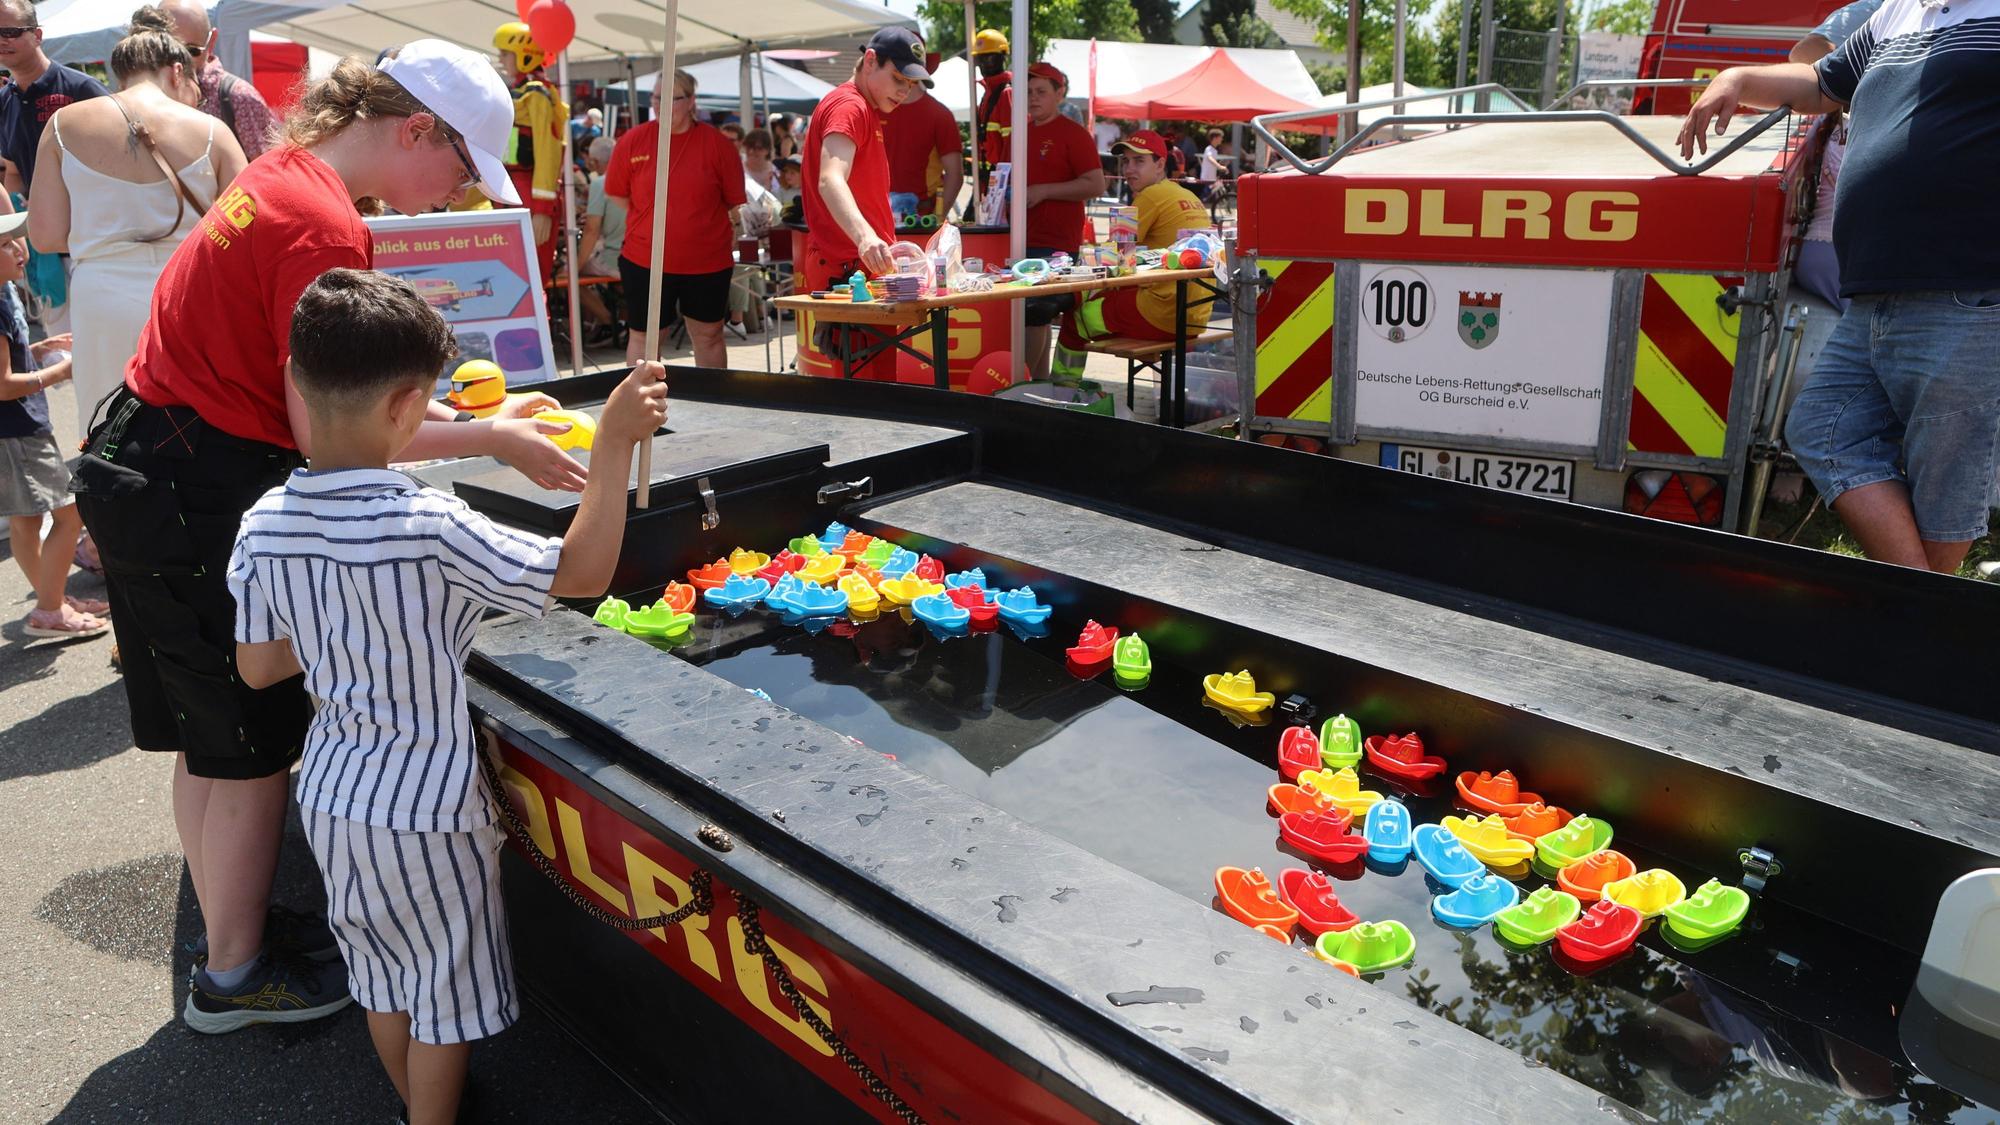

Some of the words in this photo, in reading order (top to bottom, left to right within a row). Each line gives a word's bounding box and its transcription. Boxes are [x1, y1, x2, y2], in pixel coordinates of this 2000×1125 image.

[216, 186, 257, 229] RG
[1344, 188, 1640, 241] DLRG
[373, 240, 409, 255] blick
[414, 240, 441, 252] aus
[445, 236, 470, 250] der
[475, 233, 509, 248] Luft.
[1370, 280, 1427, 328] 100
[1357, 370, 1412, 385] Deutsche
[1415, 374, 1602, 400] Lebens-Rettungs-Gesellschaft
[1419, 390, 1440, 403] OG
[1443, 392, 1505, 408] Burscheid
[1508, 398, 1530, 410] e.V.
[1497, 460, 1567, 495] 3721
